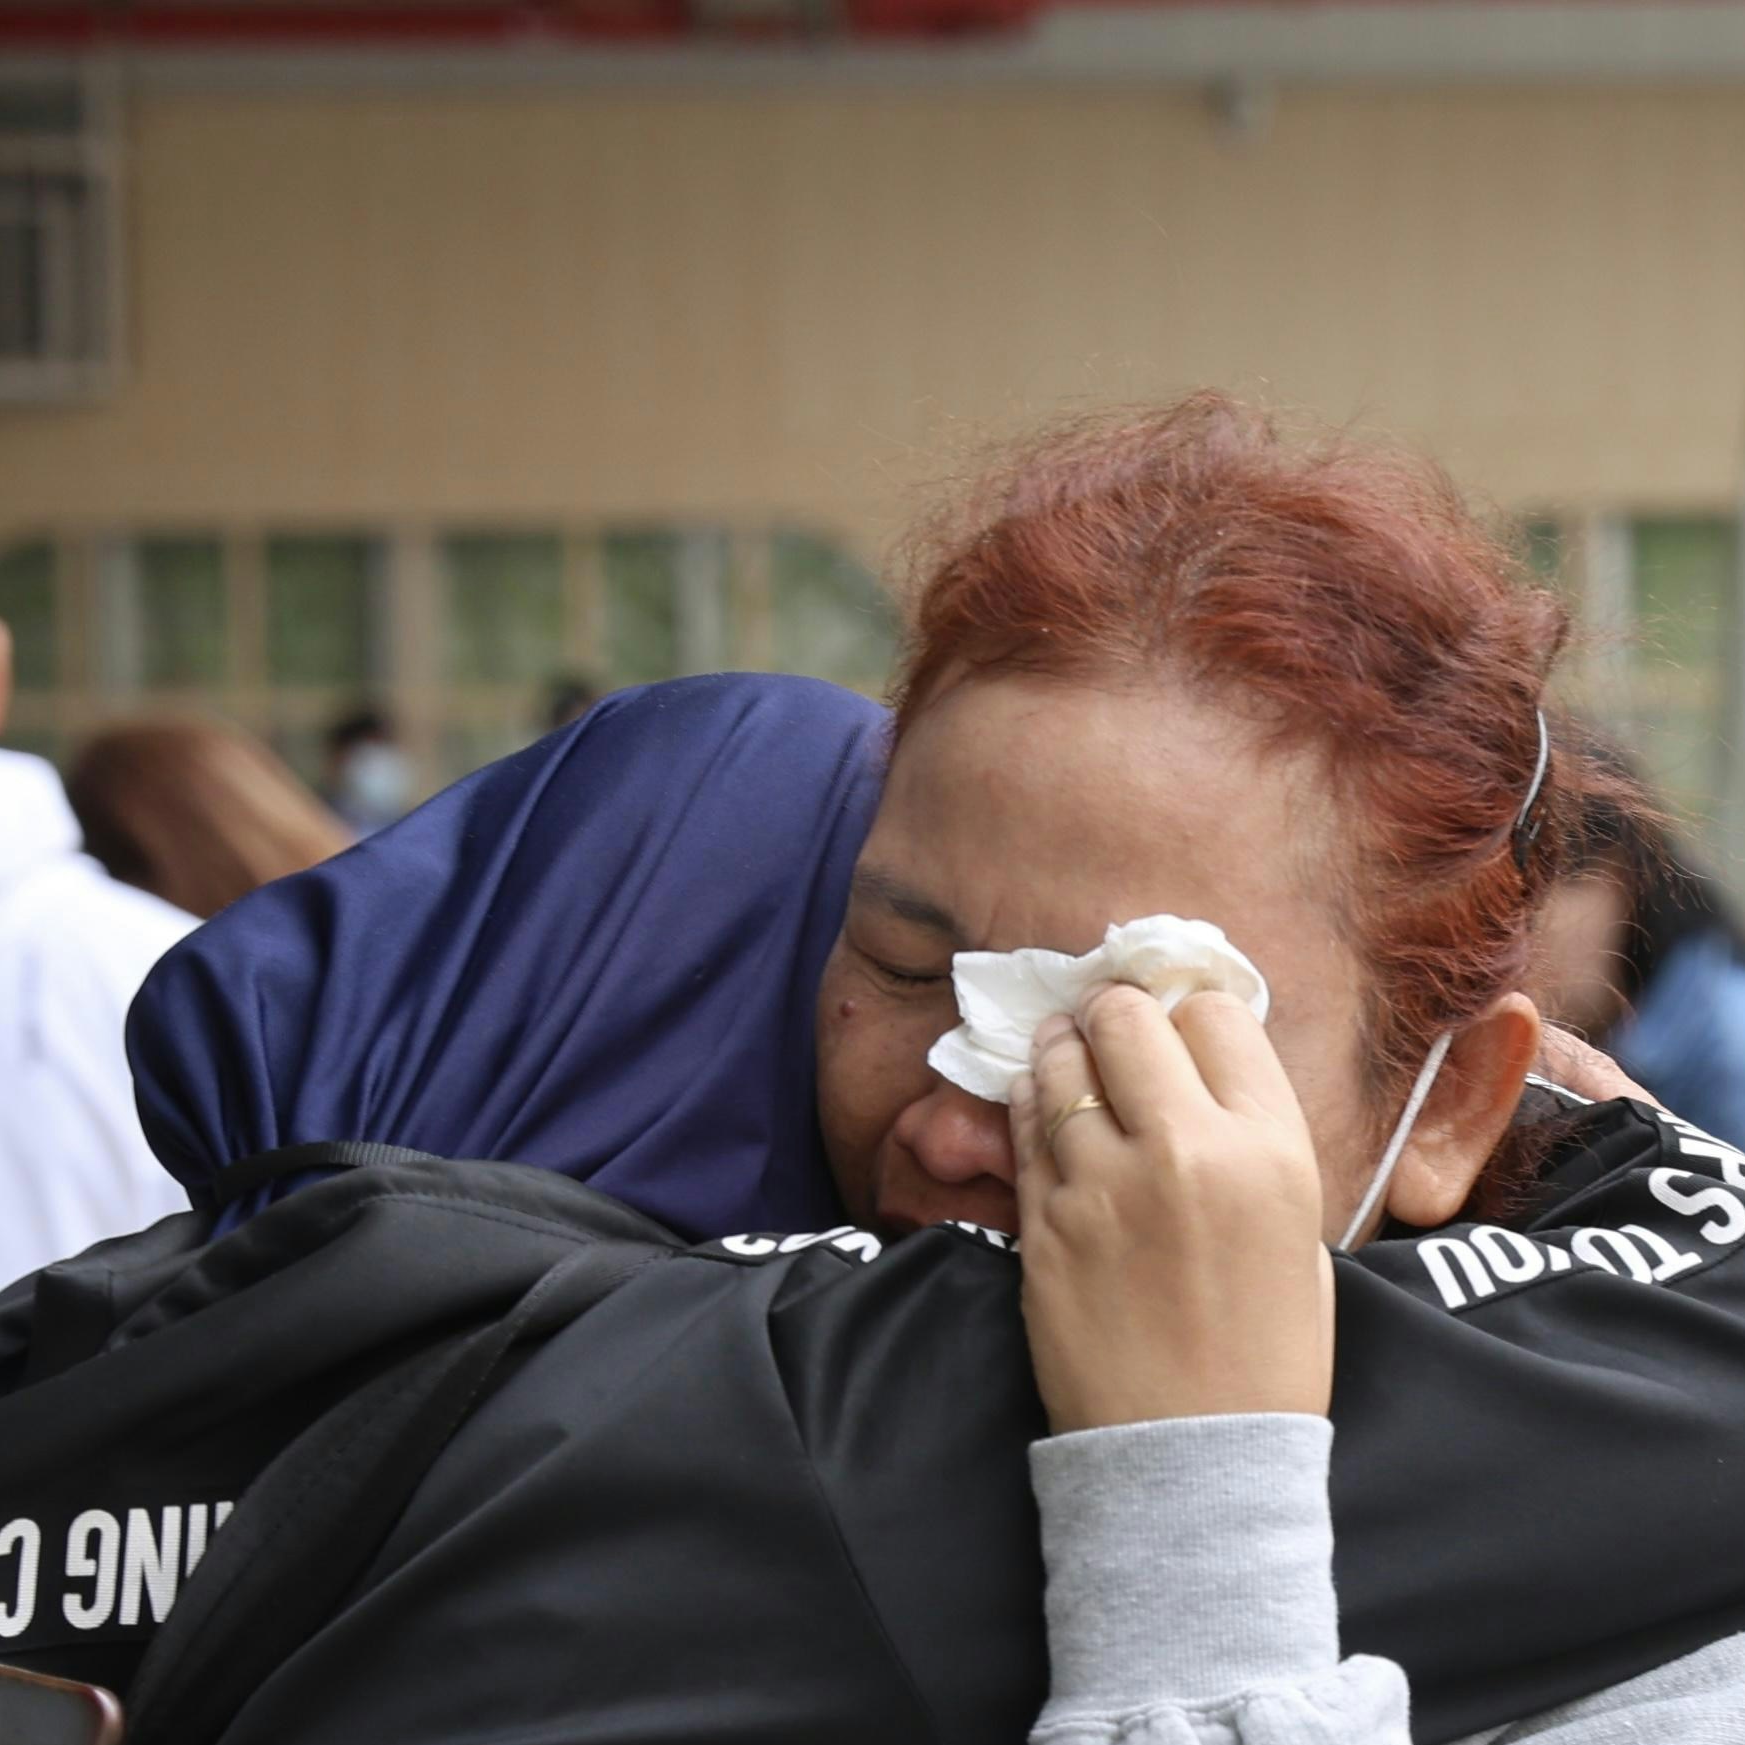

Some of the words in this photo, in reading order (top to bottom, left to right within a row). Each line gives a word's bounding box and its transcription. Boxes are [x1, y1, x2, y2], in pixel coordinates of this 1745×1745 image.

[1417, 1225, 1571, 1309] OU
[1572, 1224, 1702, 1285] TO
[63, 1501, 234, 1629] ING
